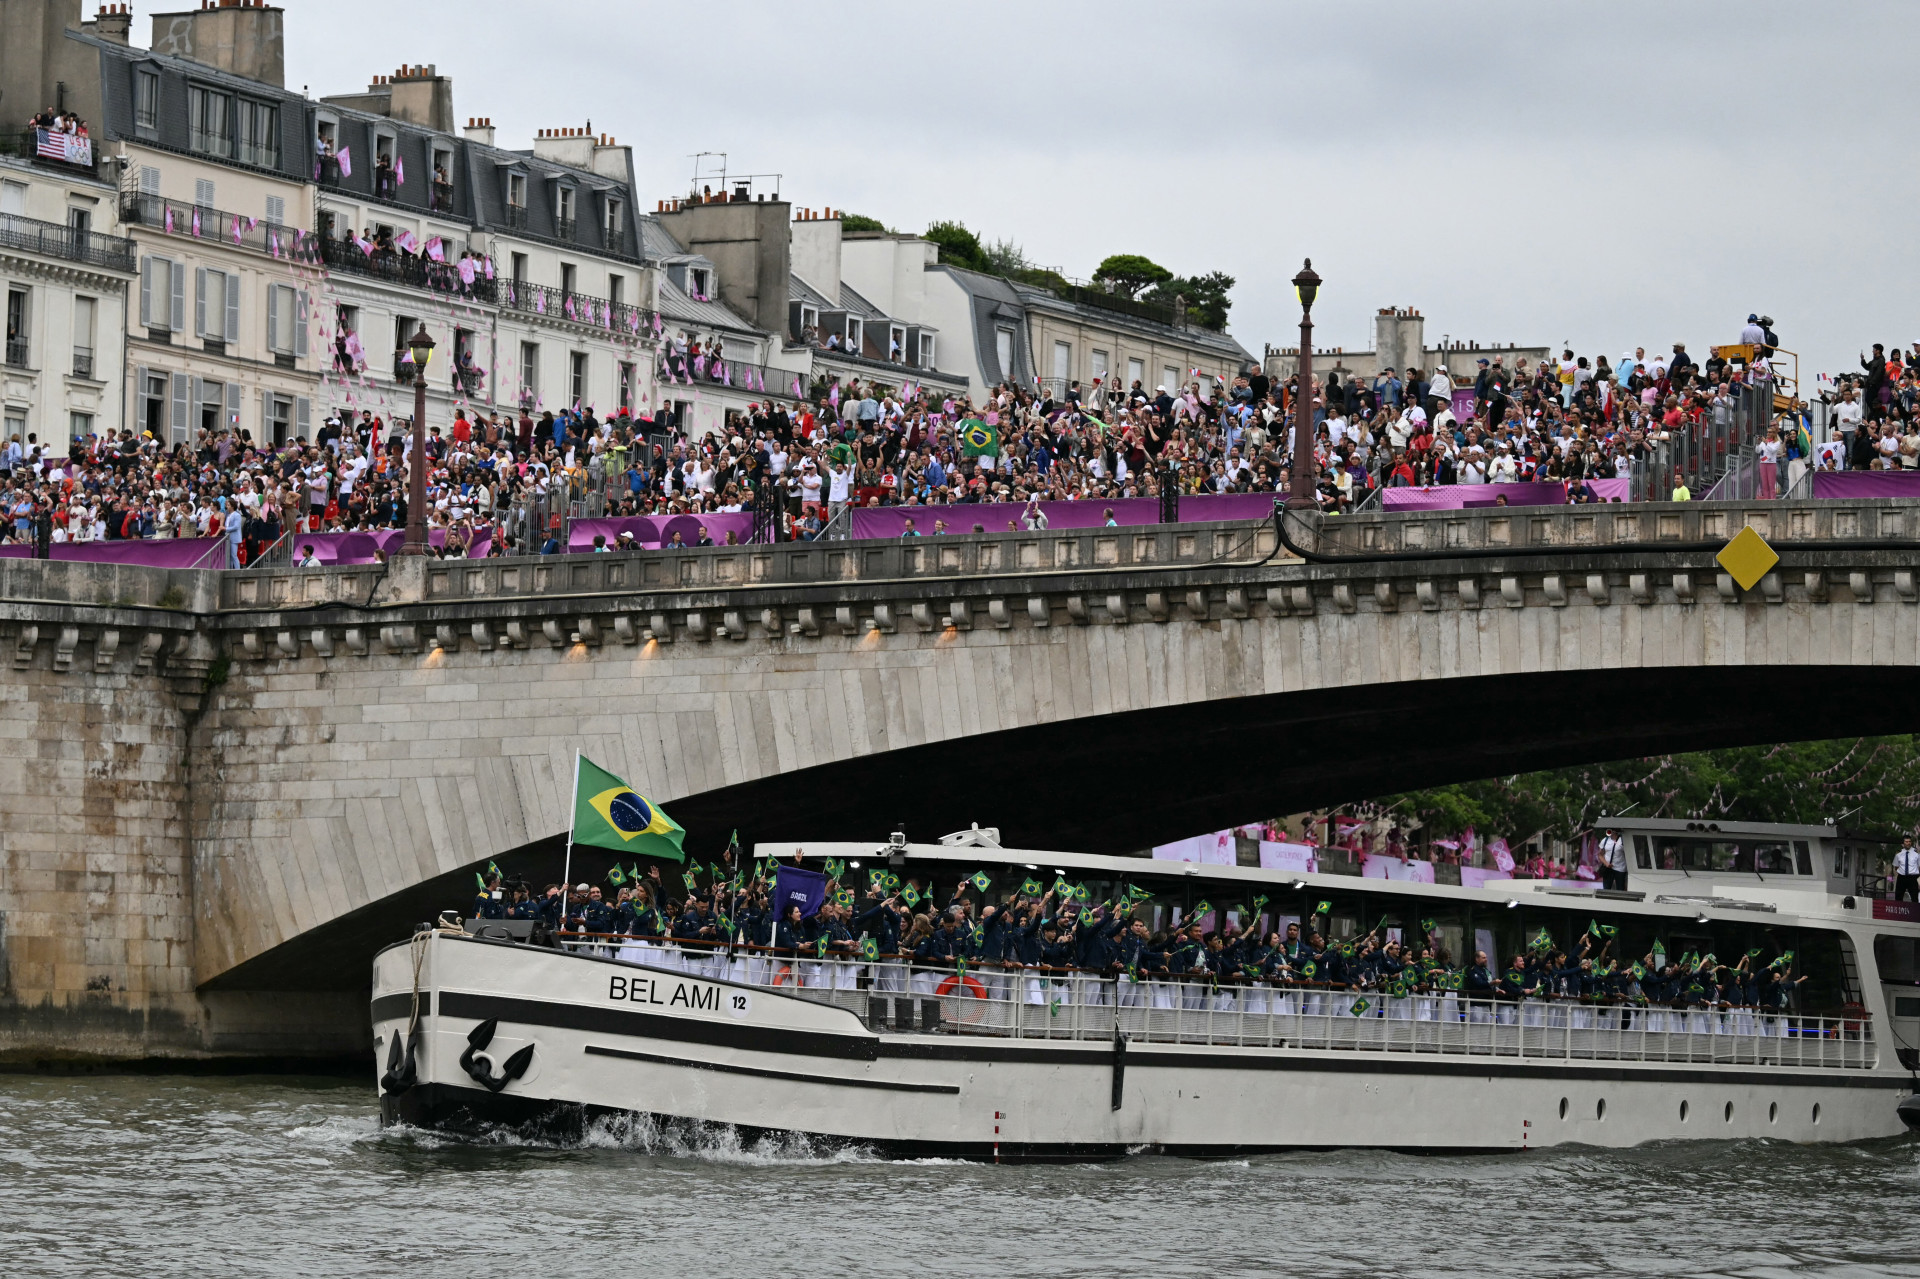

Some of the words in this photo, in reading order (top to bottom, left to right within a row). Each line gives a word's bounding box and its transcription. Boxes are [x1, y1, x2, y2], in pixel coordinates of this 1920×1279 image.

[69, 137, 88, 148] USA
[790, 891, 807, 902] BRAZIL
[1885, 906, 1898, 914] PARIS
[1898, 907, 1910, 915] 2024
[609, 975, 664, 1005] BEL
[669, 983, 721, 1011] AMI
[732, 995, 747, 1010] 12
